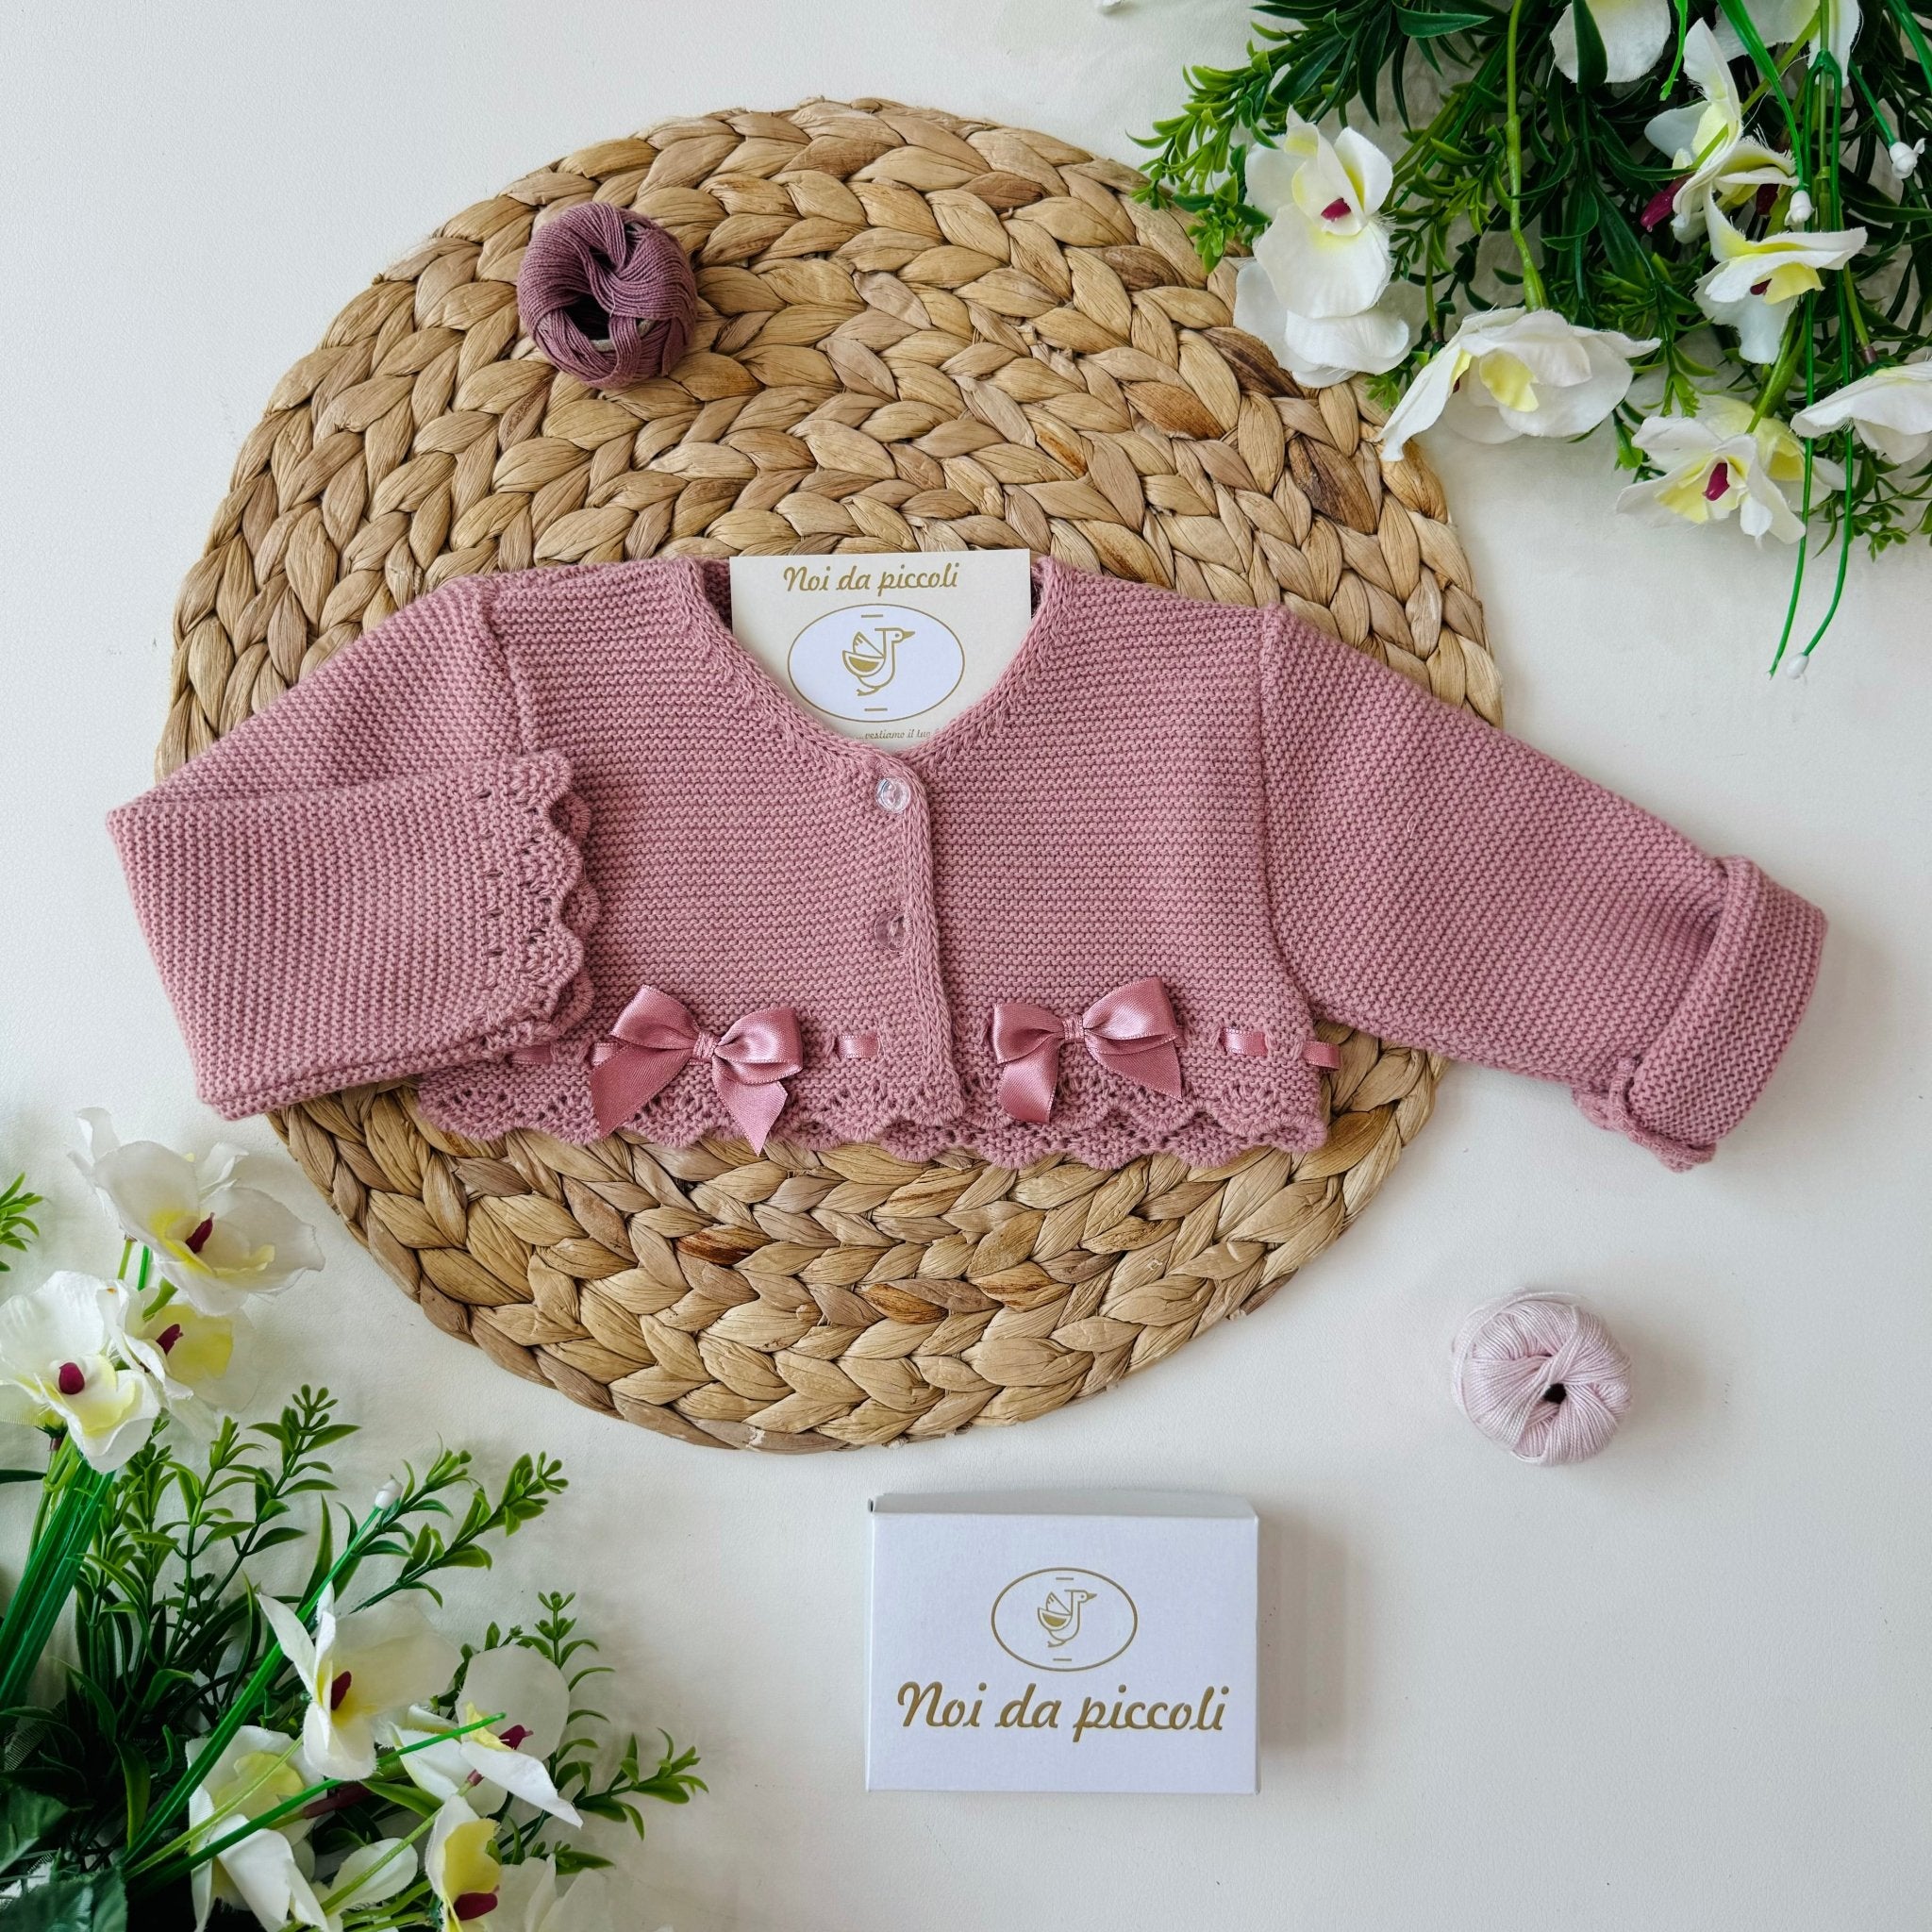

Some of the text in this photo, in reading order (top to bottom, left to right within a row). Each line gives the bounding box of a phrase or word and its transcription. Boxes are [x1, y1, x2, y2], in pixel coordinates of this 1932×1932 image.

[783, 562, 960, 596] Noi da piccoli
[897, 1681, 1230, 1743] Noi da piccoli
